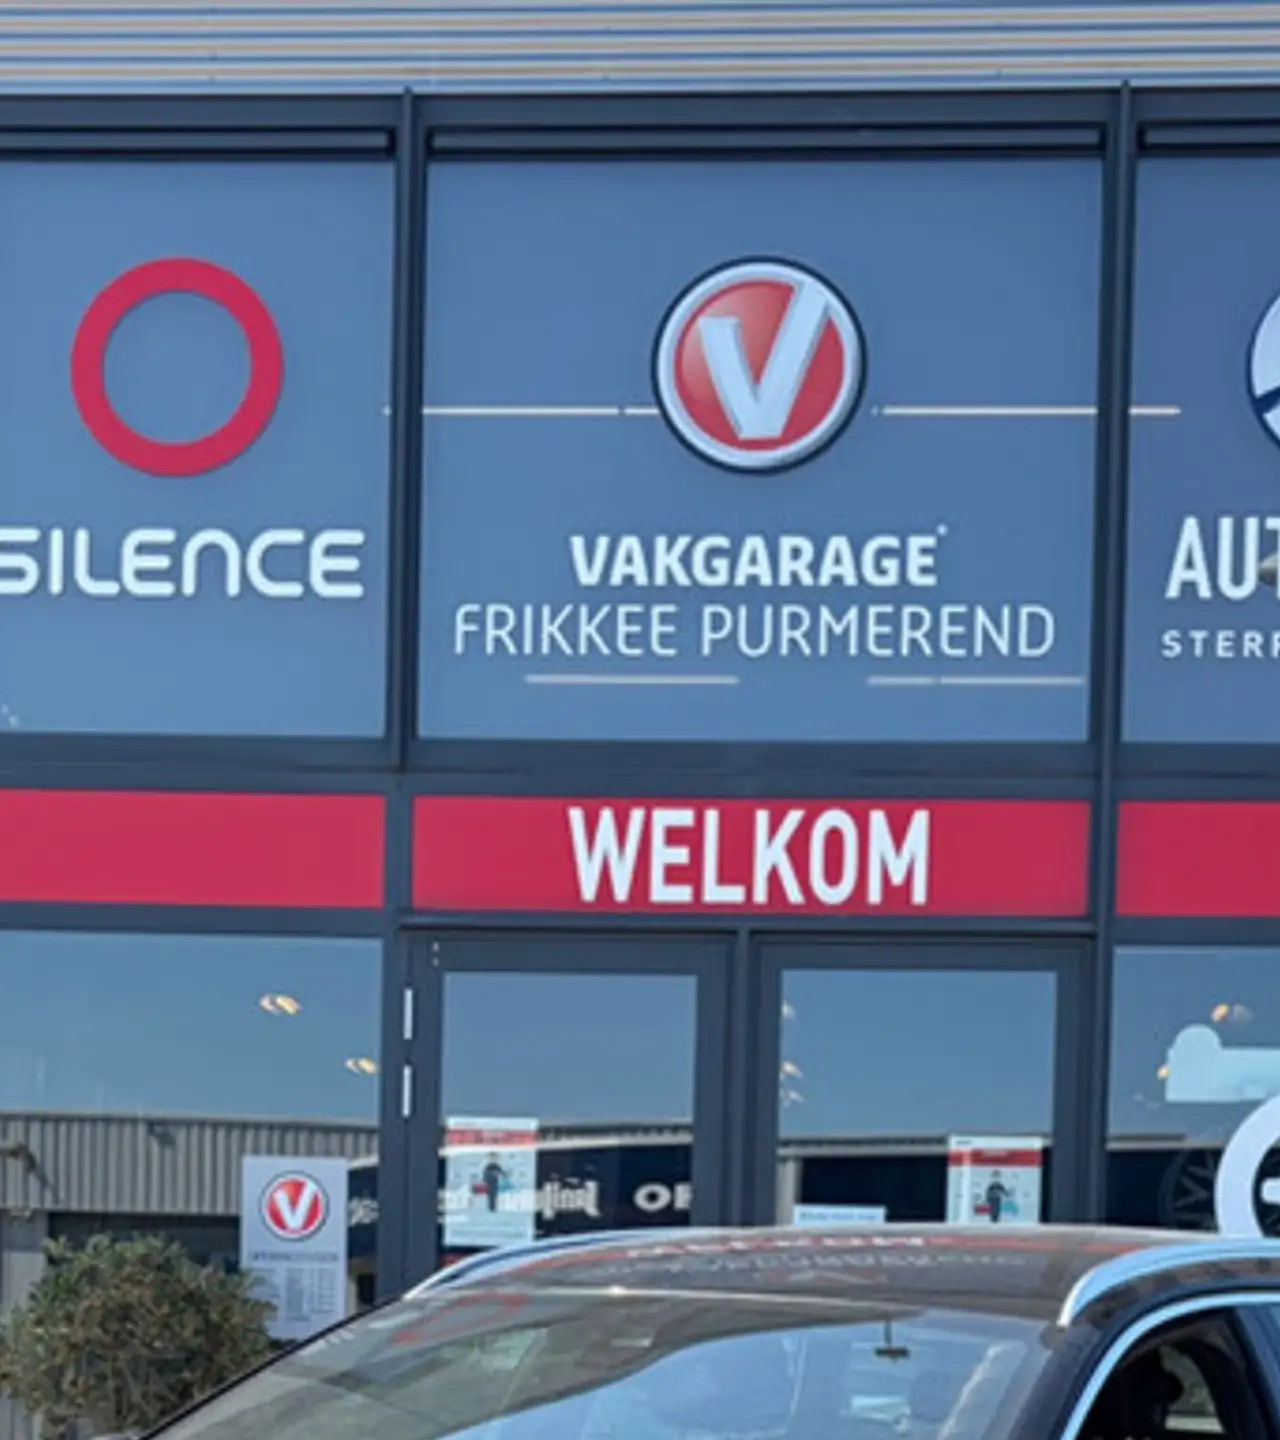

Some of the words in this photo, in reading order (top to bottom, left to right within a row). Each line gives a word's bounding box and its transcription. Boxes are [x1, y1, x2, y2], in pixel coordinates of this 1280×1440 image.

[569, 533, 938, 588] VAKGARAGE
[453, 602, 678, 656] FRIKKEE
[701, 604, 1055, 660] PURMEREND
[568, 806, 931, 906] WELKOM
